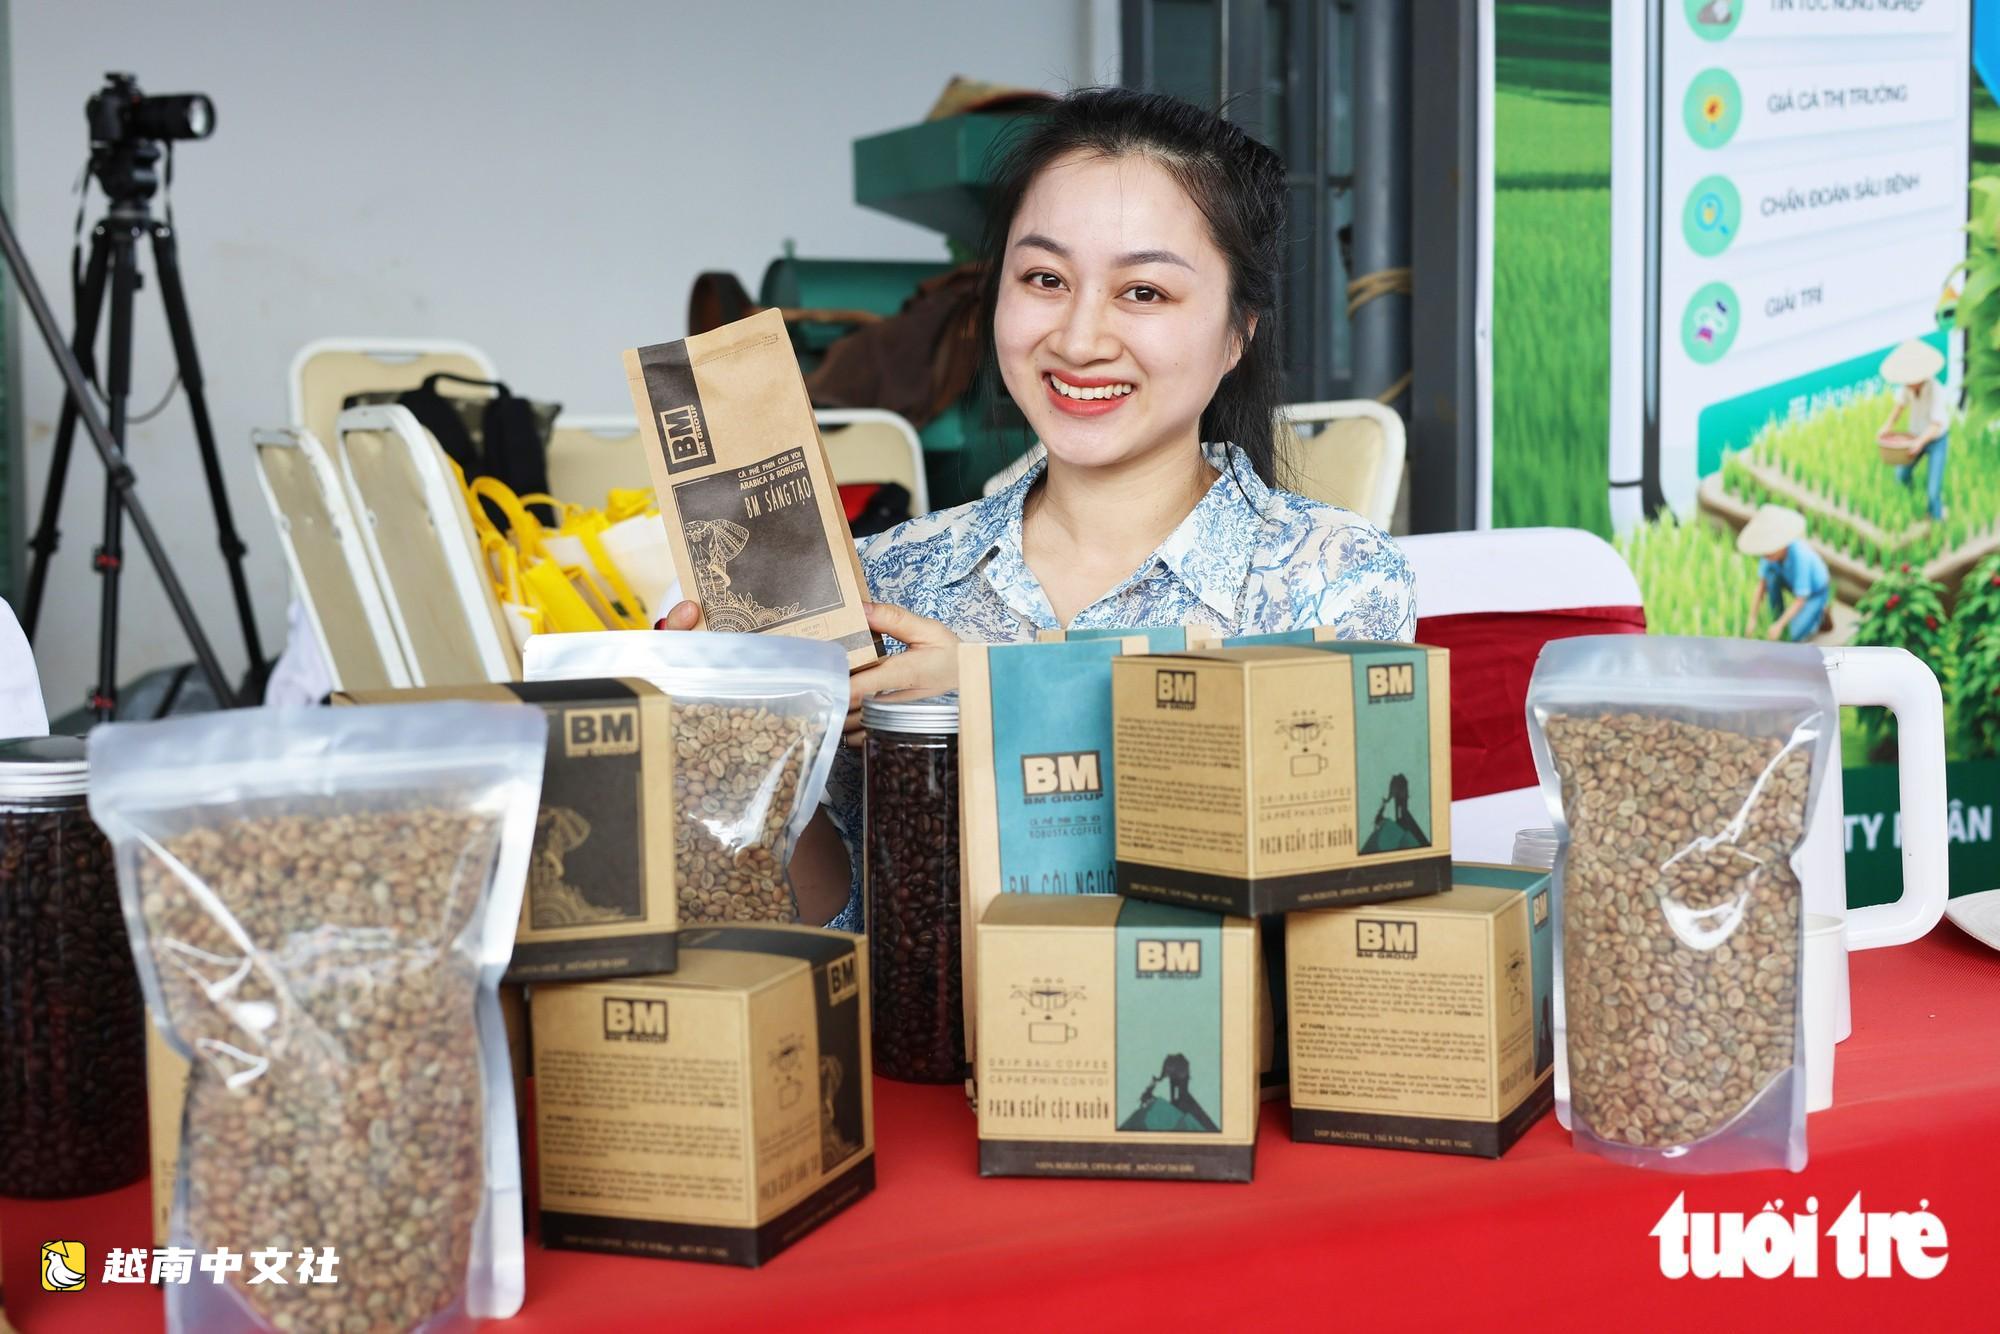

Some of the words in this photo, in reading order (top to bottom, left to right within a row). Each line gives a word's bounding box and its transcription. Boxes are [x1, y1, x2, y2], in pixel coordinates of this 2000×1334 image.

[662, 408, 700, 462] BM
[690, 404, 704, 439] GROUP
[700, 441, 708, 457] BM
[737, 470, 747, 478] CÀ
[748, 465, 760, 476] PHÊ
[762, 460, 776, 471] PHIN
[777, 455, 789, 464] CON
[740, 475, 768, 491] ARABICA
[776, 462, 805, 478] ROBUSTA
[744, 494, 761, 519] BM
[1158, 672, 1194, 703] BM
[1369, 665, 1412, 696] BM
[572, 713, 633, 744] BM
[1024, 754, 1100, 795] BM
[1023, 796, 1046, 805] BM
[1051, 792, 1104, 804] GROUP
[1029, 828, 1068, 839] ROBUSTA
[1070, 826, 1102, 836] COFFEE
[1359, 922, 1415, 952] BM
[1138, 941, 1199, 971] BM
[831, 958, 855, 993] BM
[607, 1001, 664, 1033] BM
[989, 1058, 1020, 1067] DRIP
[1055, 1059, 1108, 1069] COFFEE
[989, 1099, 1014, 1117] PHIN
[1020, 1094, 1046, 1118] GIẤY
[1051, 1096, 1071, 1123] CỘI
[1075, 1096, 1108, 1119] NGUỒN
